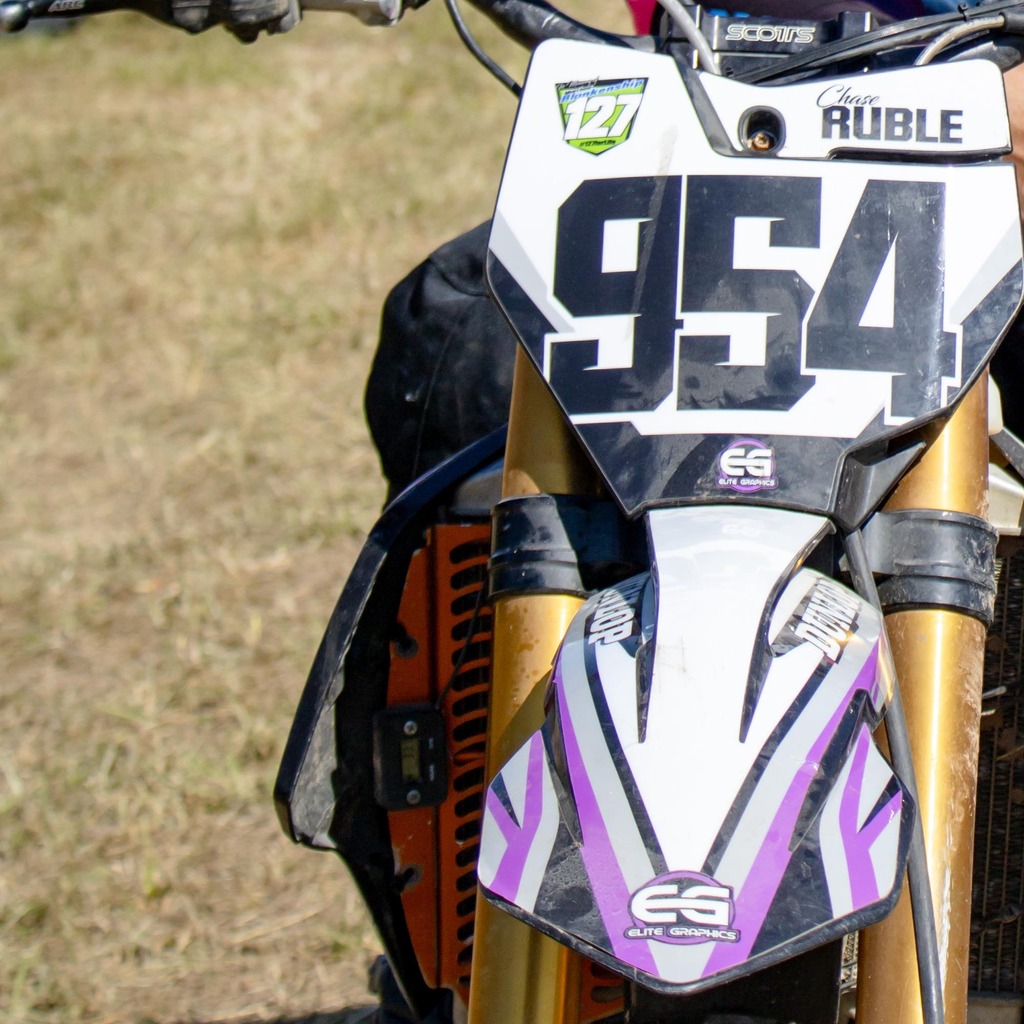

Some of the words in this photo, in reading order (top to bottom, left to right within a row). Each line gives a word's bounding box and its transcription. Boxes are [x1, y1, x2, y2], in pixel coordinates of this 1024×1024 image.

[725, 23, 816, 44] SCOTTS
[816, 84, 880, 108] Chase
[563, 93, 643, 140] 127
[821, 105, 963, 144] RUBLE
[549, 174, 958, 419] 954
[718, 478, 738, 486] ELITE
[740, 478, 775, 487] GRAPHICS
[628, 927, 664, 937] ELITE
[669, 927, 737, 940] GRAPHICS
